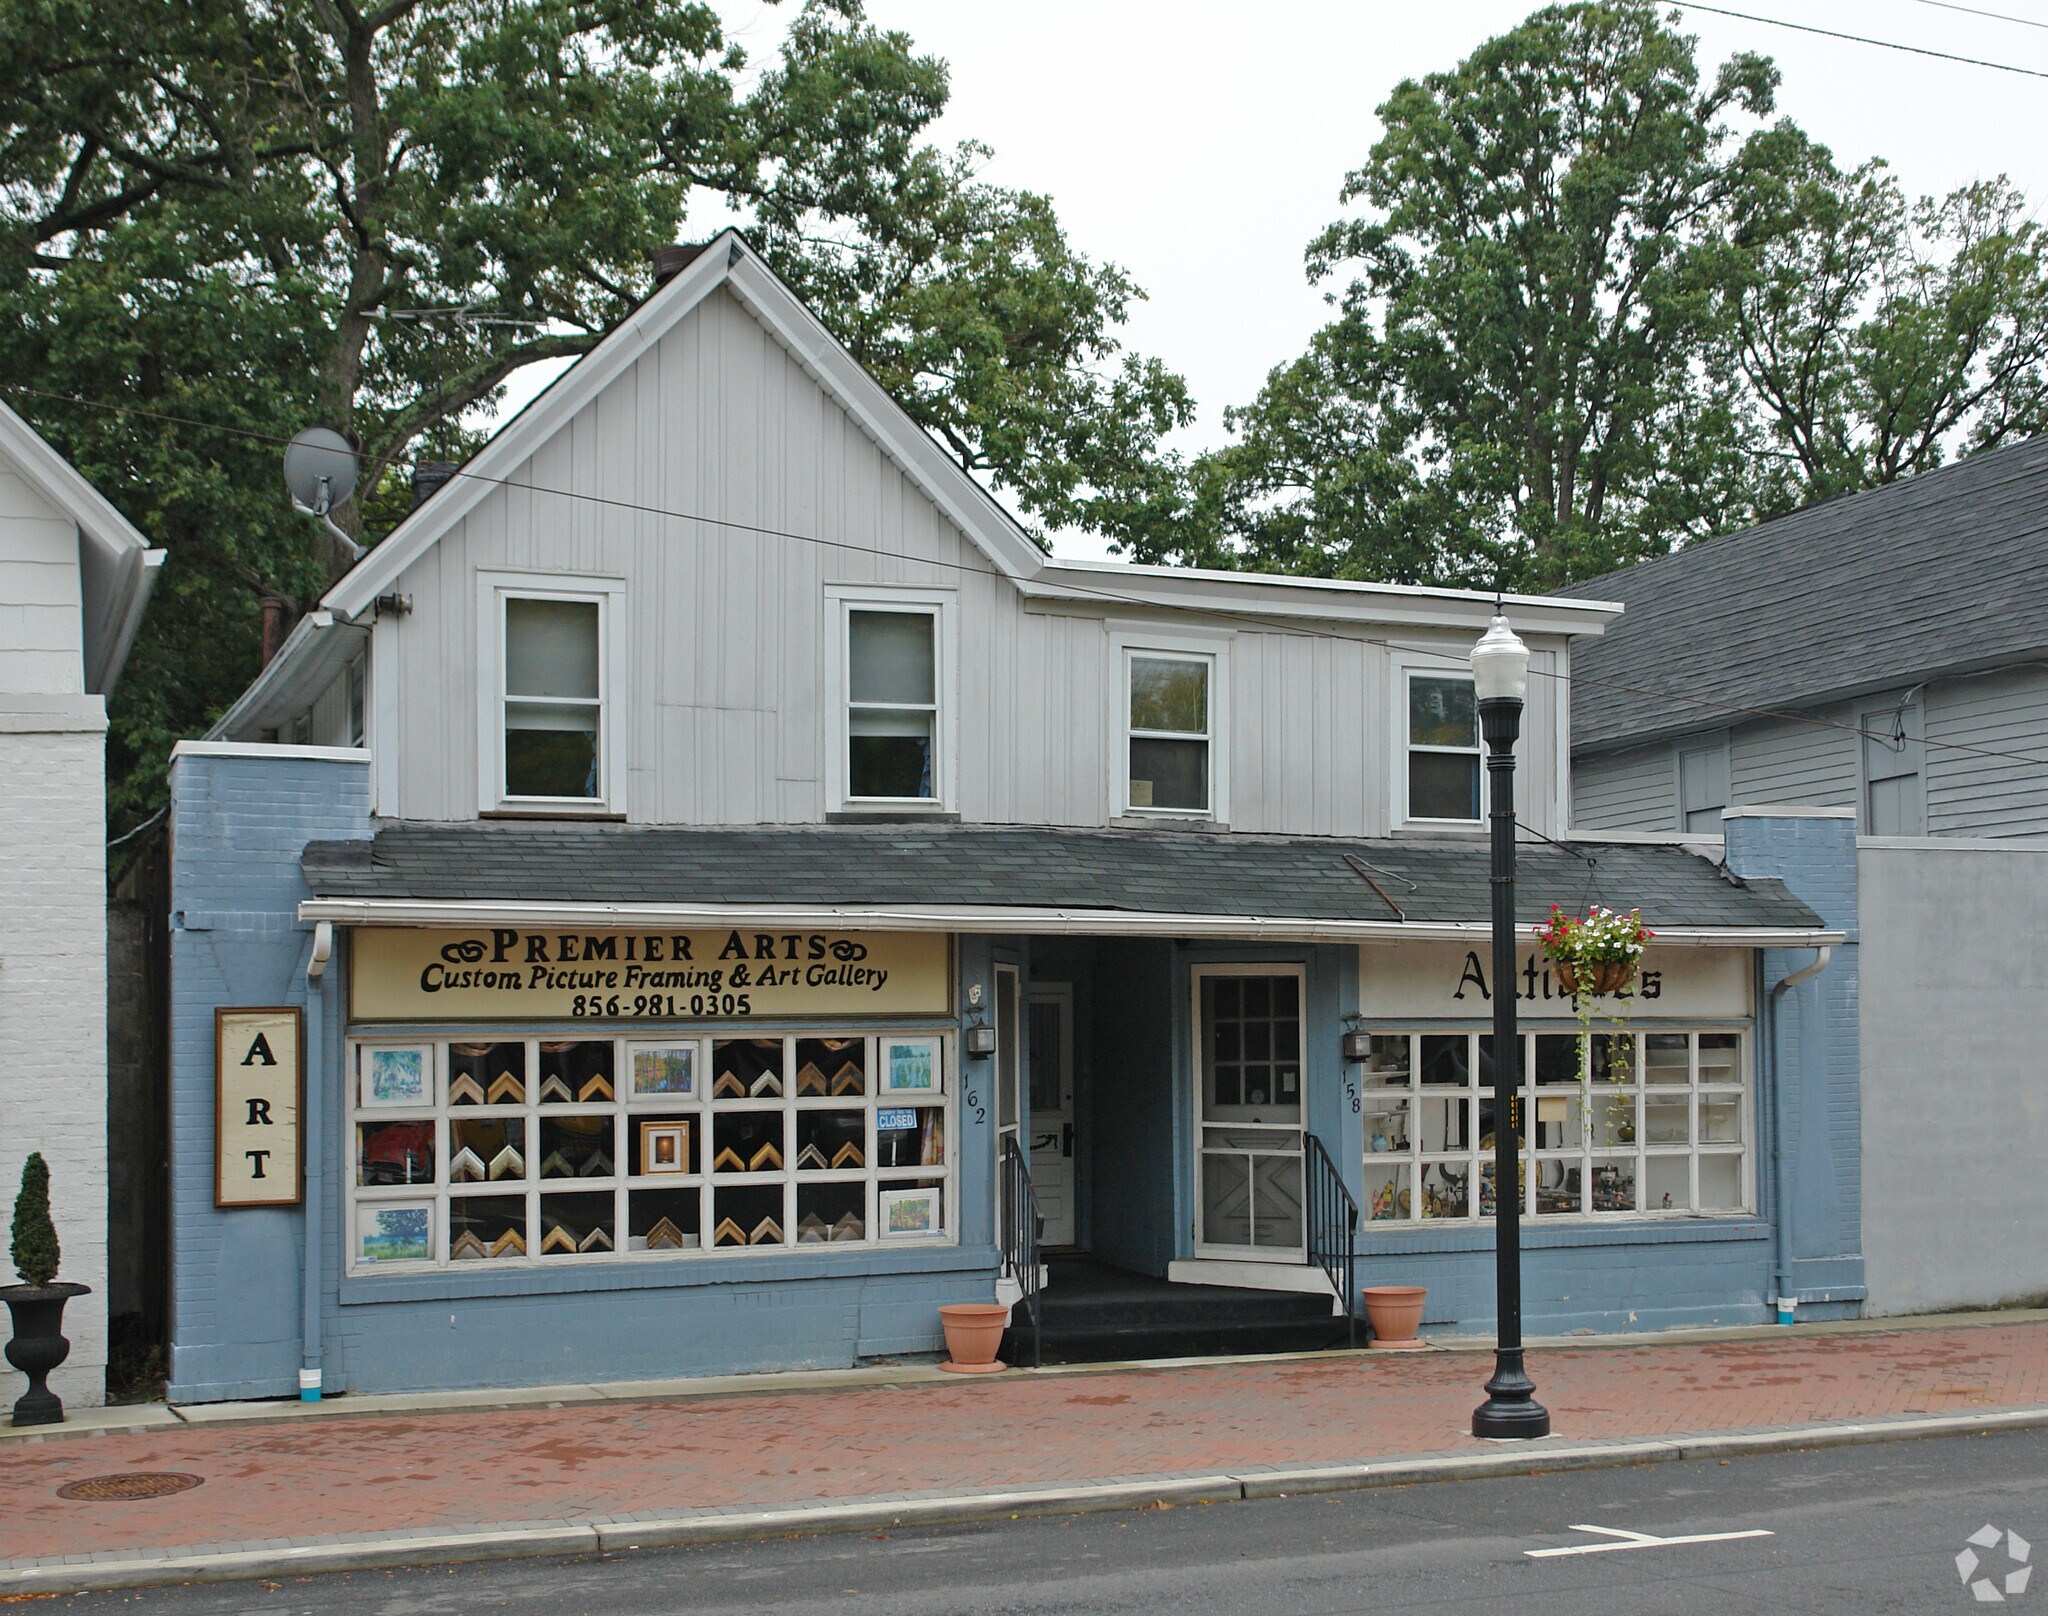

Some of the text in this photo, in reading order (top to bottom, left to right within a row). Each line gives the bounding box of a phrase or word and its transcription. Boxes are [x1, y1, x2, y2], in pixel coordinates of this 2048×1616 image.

[490, 928, 826, 962] PREMIER ARTS
[420, 963, 888, 993] Custom Picture Framing & Art Gallery
[1453, 951, 1661, 1011] Atis
[572, 994, 751, 1016] 856-981-0305
[240, 1032, 277, 1178] ART
[964, 1074, 985, 1124] 162
[1341, 1069, 1361, 1114] 158
[879, 1115, 912, 1127] CLOSED
